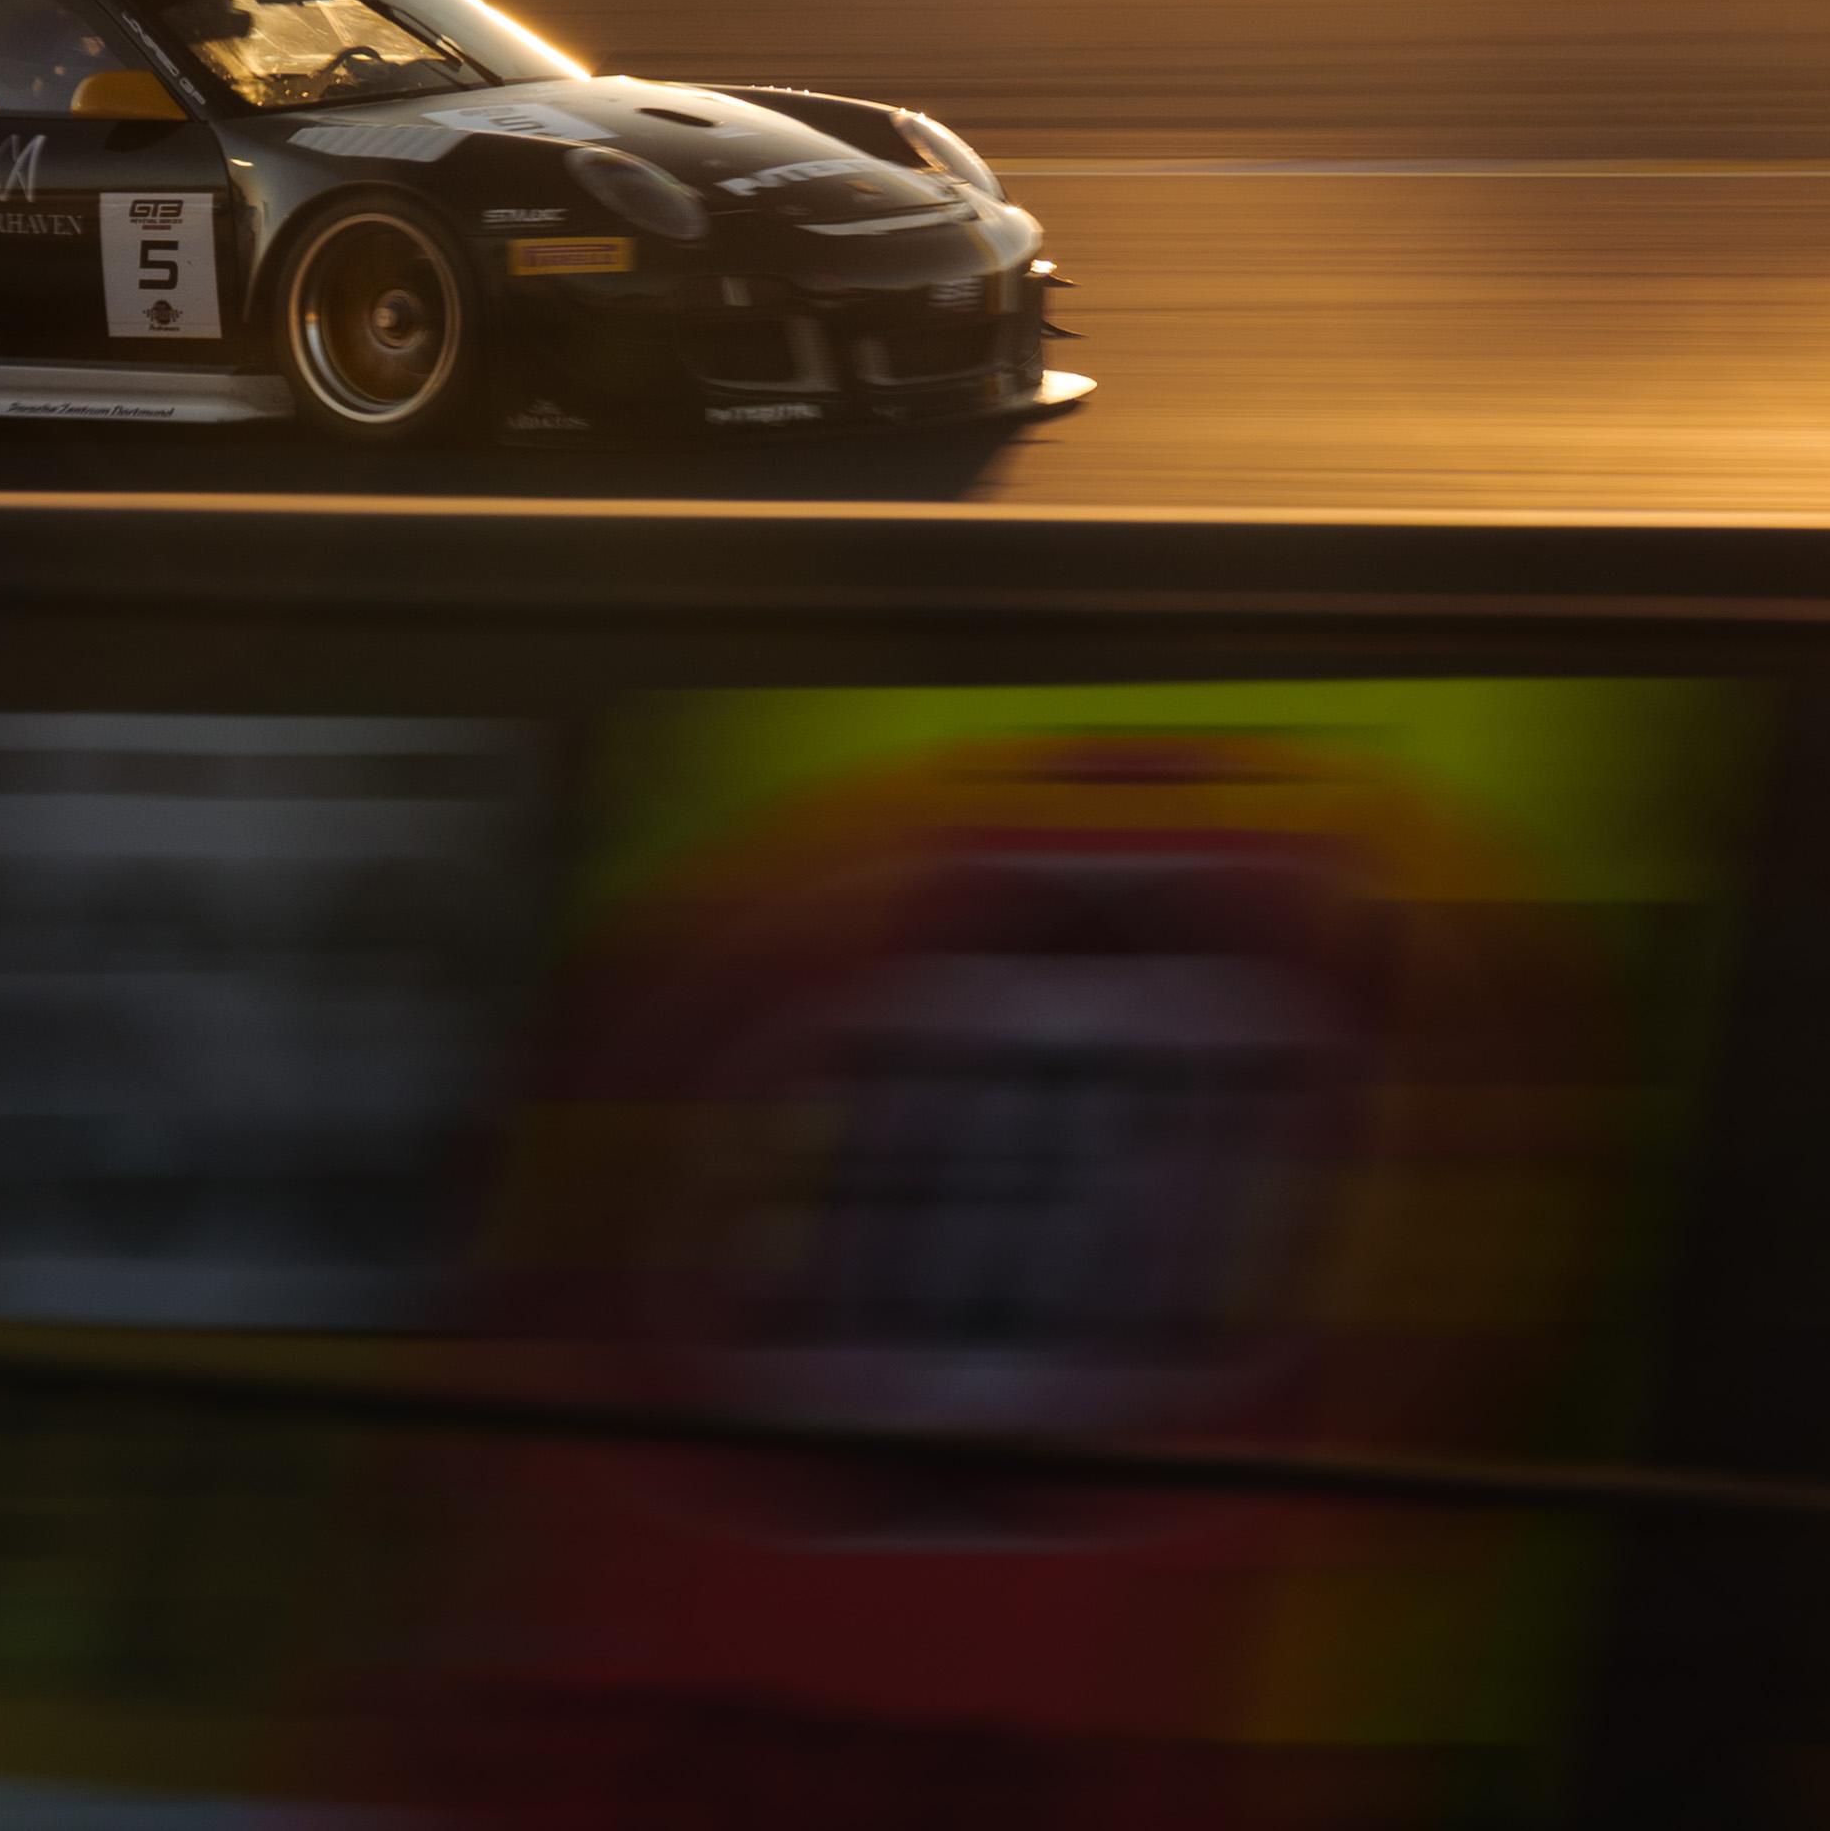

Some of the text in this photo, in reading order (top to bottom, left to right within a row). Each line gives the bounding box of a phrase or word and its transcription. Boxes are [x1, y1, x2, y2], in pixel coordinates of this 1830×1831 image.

[179, 76, 206, 105] GP
[129, 199, 184, 218] GT3
[138, 239, 179, 291] 5
[108, 405, 175, 418] Dortmund
